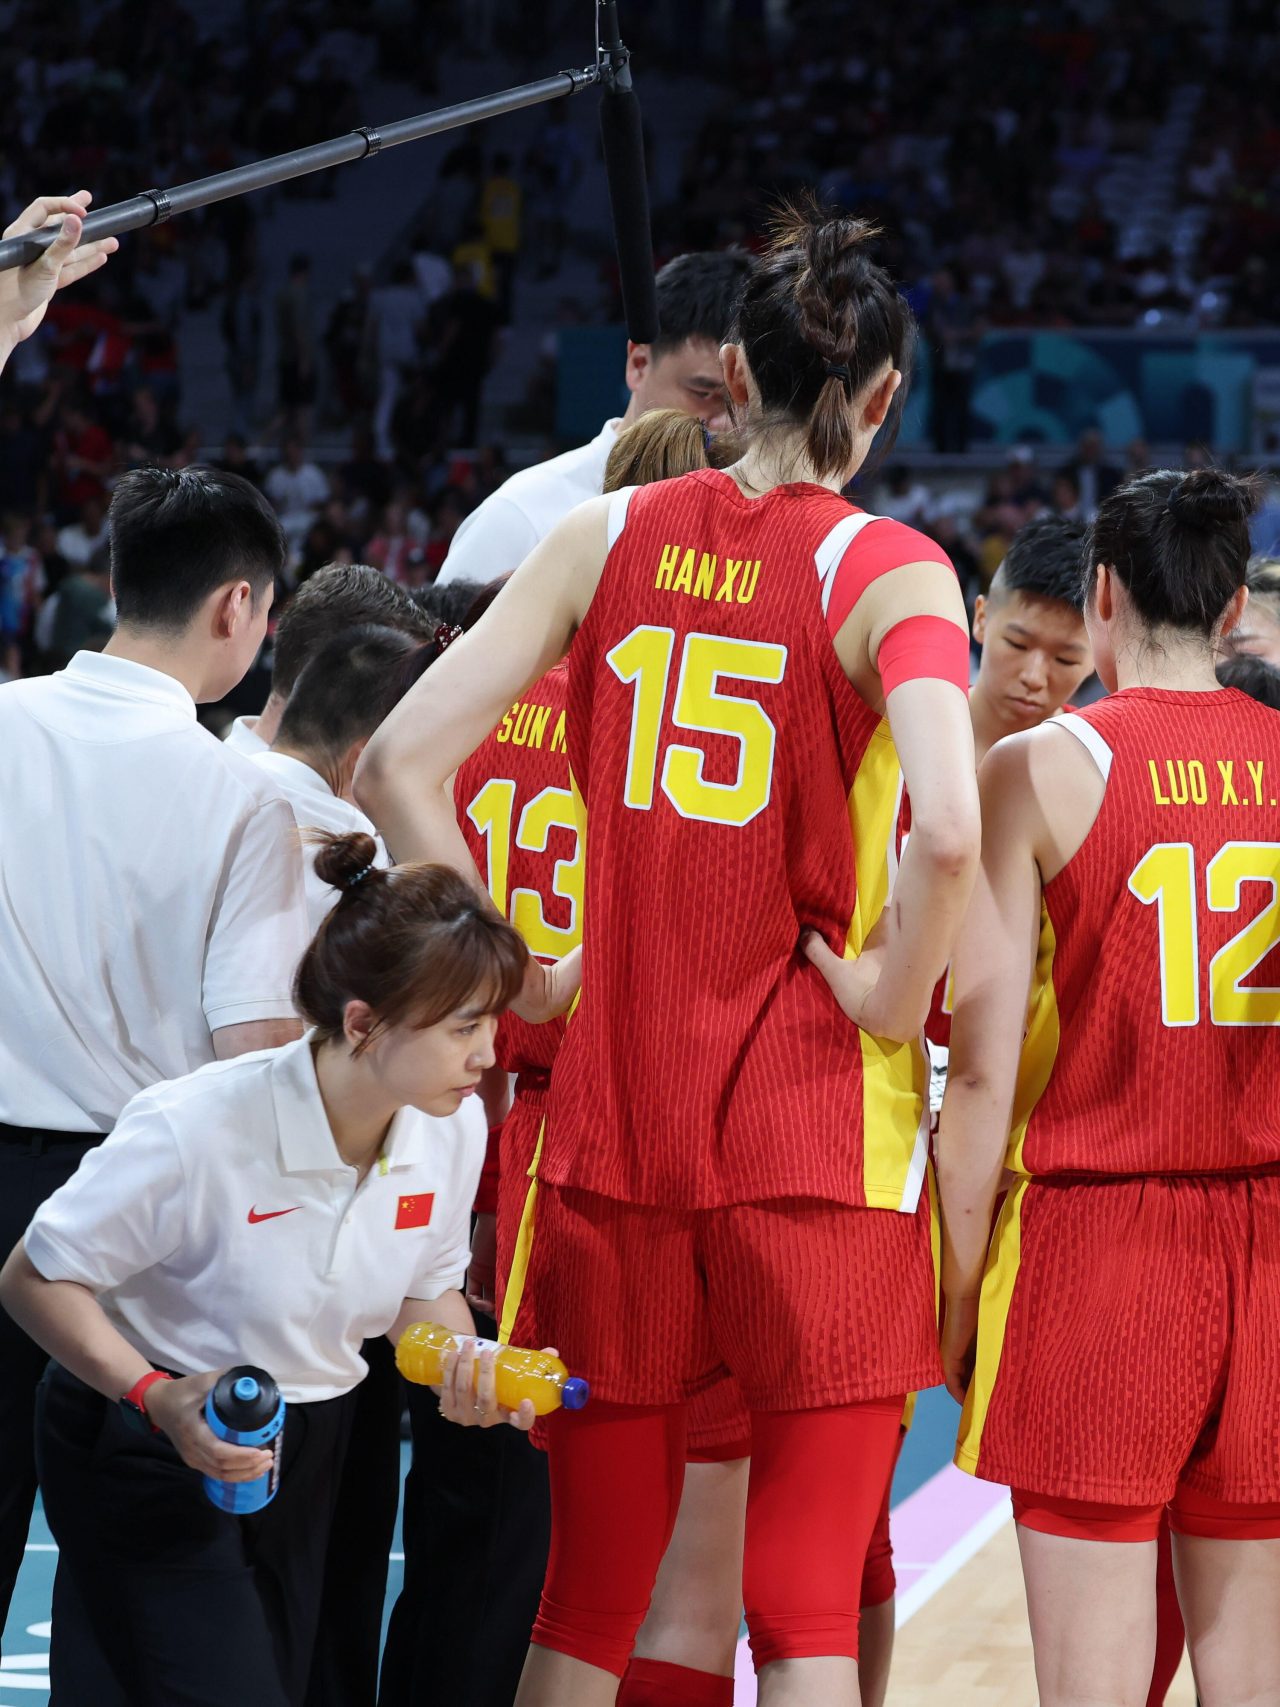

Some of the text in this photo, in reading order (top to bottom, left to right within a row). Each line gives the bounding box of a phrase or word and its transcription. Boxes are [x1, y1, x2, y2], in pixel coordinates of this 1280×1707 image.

[655, 545, 761, 604] HAN XU
[497, 702, 552, 749] SUN
[606, 625, 788, 827] 15
[1148, 760, 1277, 805] LUO X.Y.
[466, 778, 584, 961] 13
